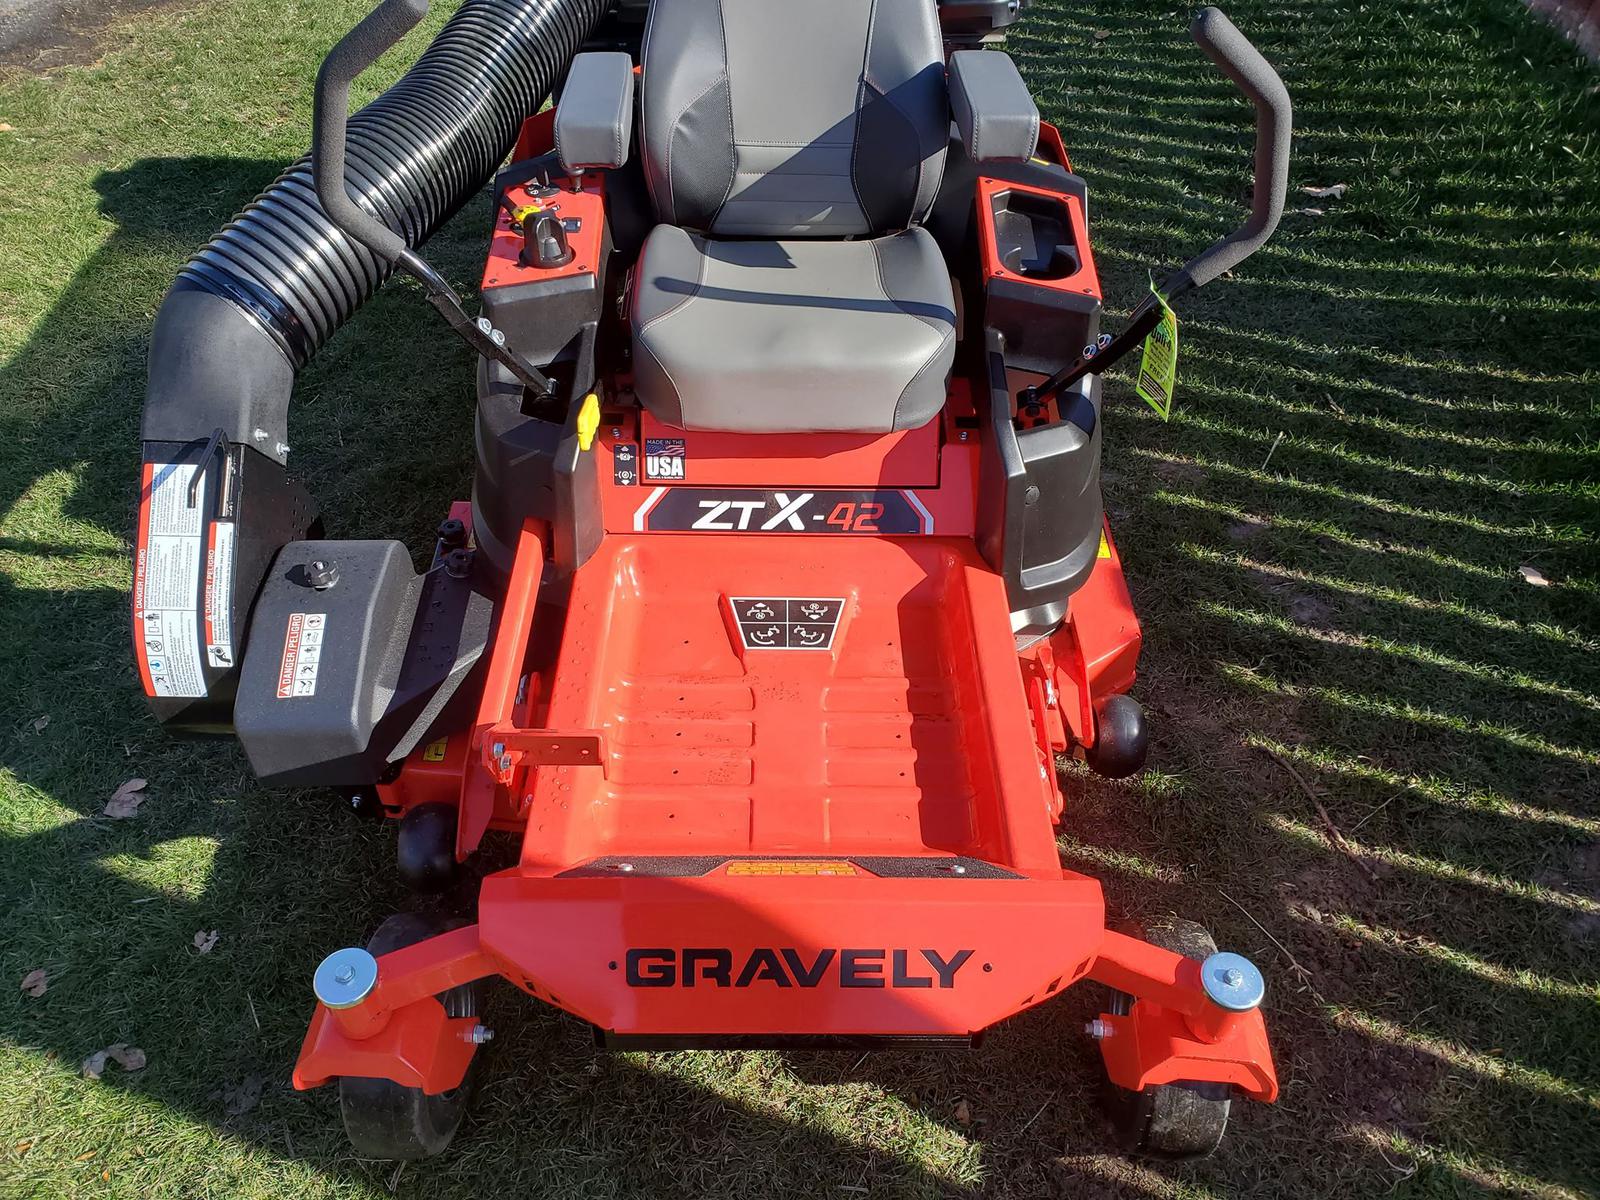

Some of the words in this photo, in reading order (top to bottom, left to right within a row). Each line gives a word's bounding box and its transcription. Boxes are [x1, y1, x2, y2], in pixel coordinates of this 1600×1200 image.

[647, 456, 684, 476] USA
[691, 492, 885, 531] ZTX-42
[138, 548, 146, 576] PELIGRO
[207, 549, 215, 579] PELIGRO
[136, 581, 144, 609] DANGER
[205, 585, 213, 614] DANGER
[625, 948, 976, 989] GRAVELY
